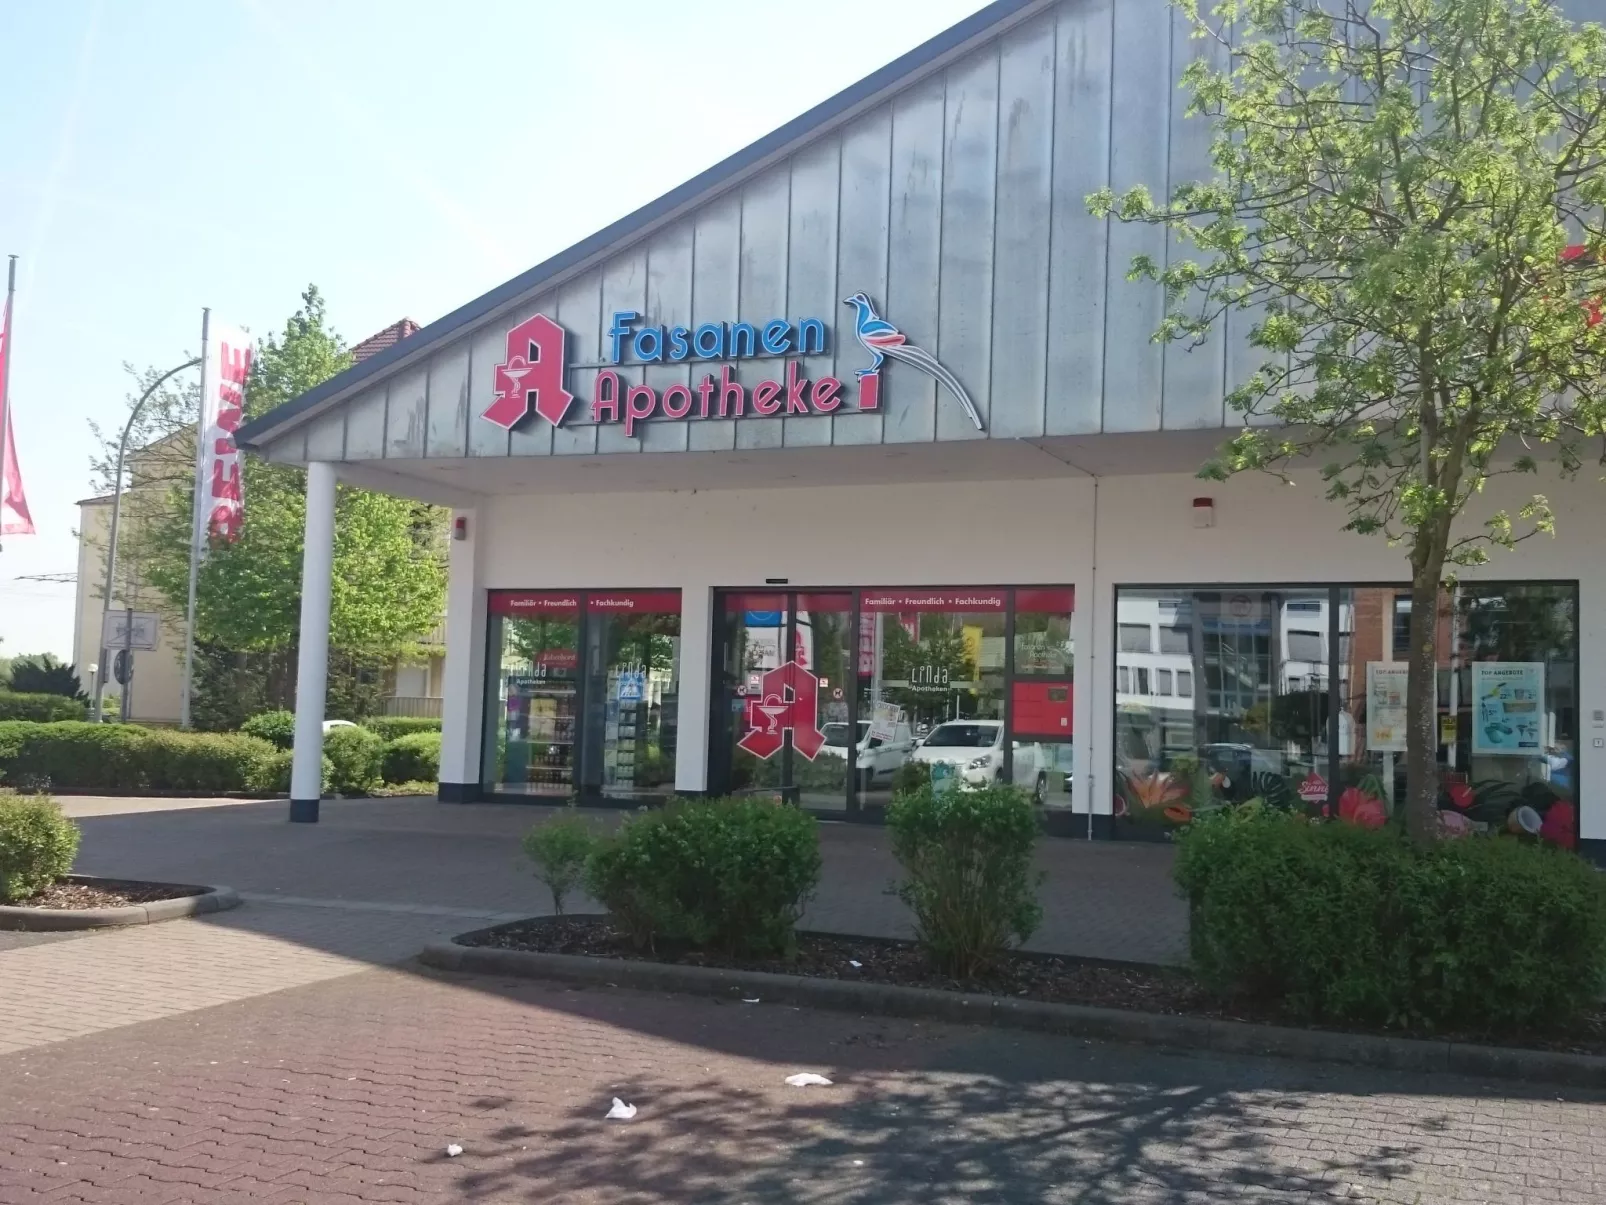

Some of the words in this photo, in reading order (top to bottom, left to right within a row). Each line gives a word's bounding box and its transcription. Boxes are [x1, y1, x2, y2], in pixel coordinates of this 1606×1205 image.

[608, 310, 826, 364] Fasanen
[589, 361, 842, 438] Apotheke
[207, 340, 252, 543] REWE
[510, 598, 536, 607] Familiär
[544, 598, 577, 607] Freundlich
[595, 598, 634, 609] Fachkundig
[865, 597, 896, 605] Familiär
[905, 597, 945, 605] Freundlich
[955, 597, 1001, 607] Fachkundig
